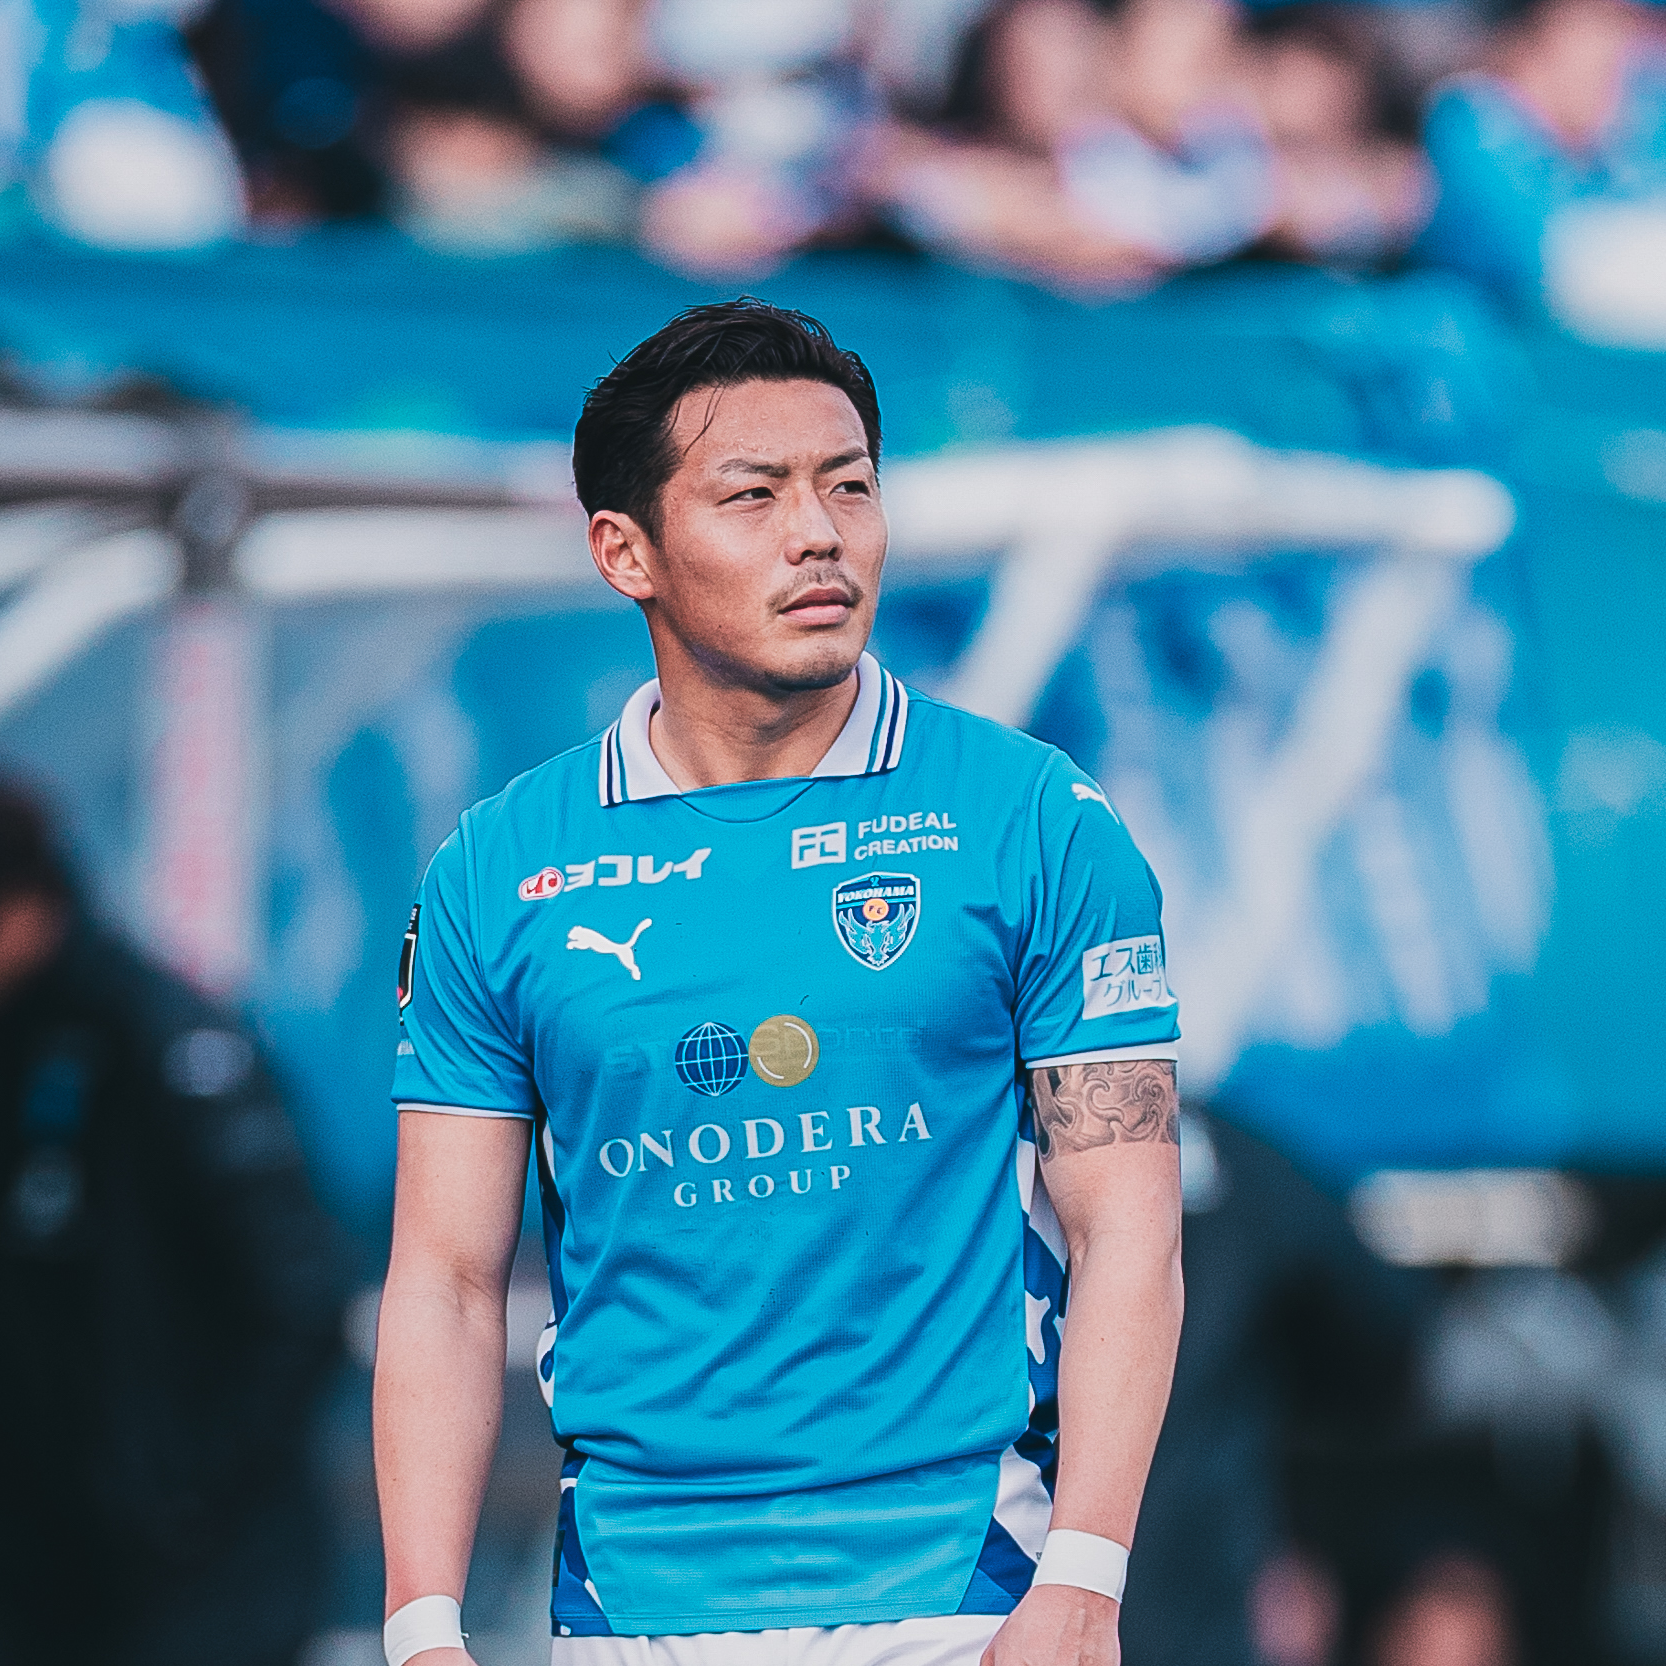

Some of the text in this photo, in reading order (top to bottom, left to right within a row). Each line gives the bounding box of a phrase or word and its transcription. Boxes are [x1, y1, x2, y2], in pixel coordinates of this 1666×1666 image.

[858, 811, 957, 839] FUDEAL
[854, 834, 958, 861] CREATION
[563, 847, 712, 892] ヨコレイ
[837, 885, 915, 904] YOKOHAMA
[599, 1101, 933, 1178] ONODERA
[673, 1165, 851, 1208] GROUP
